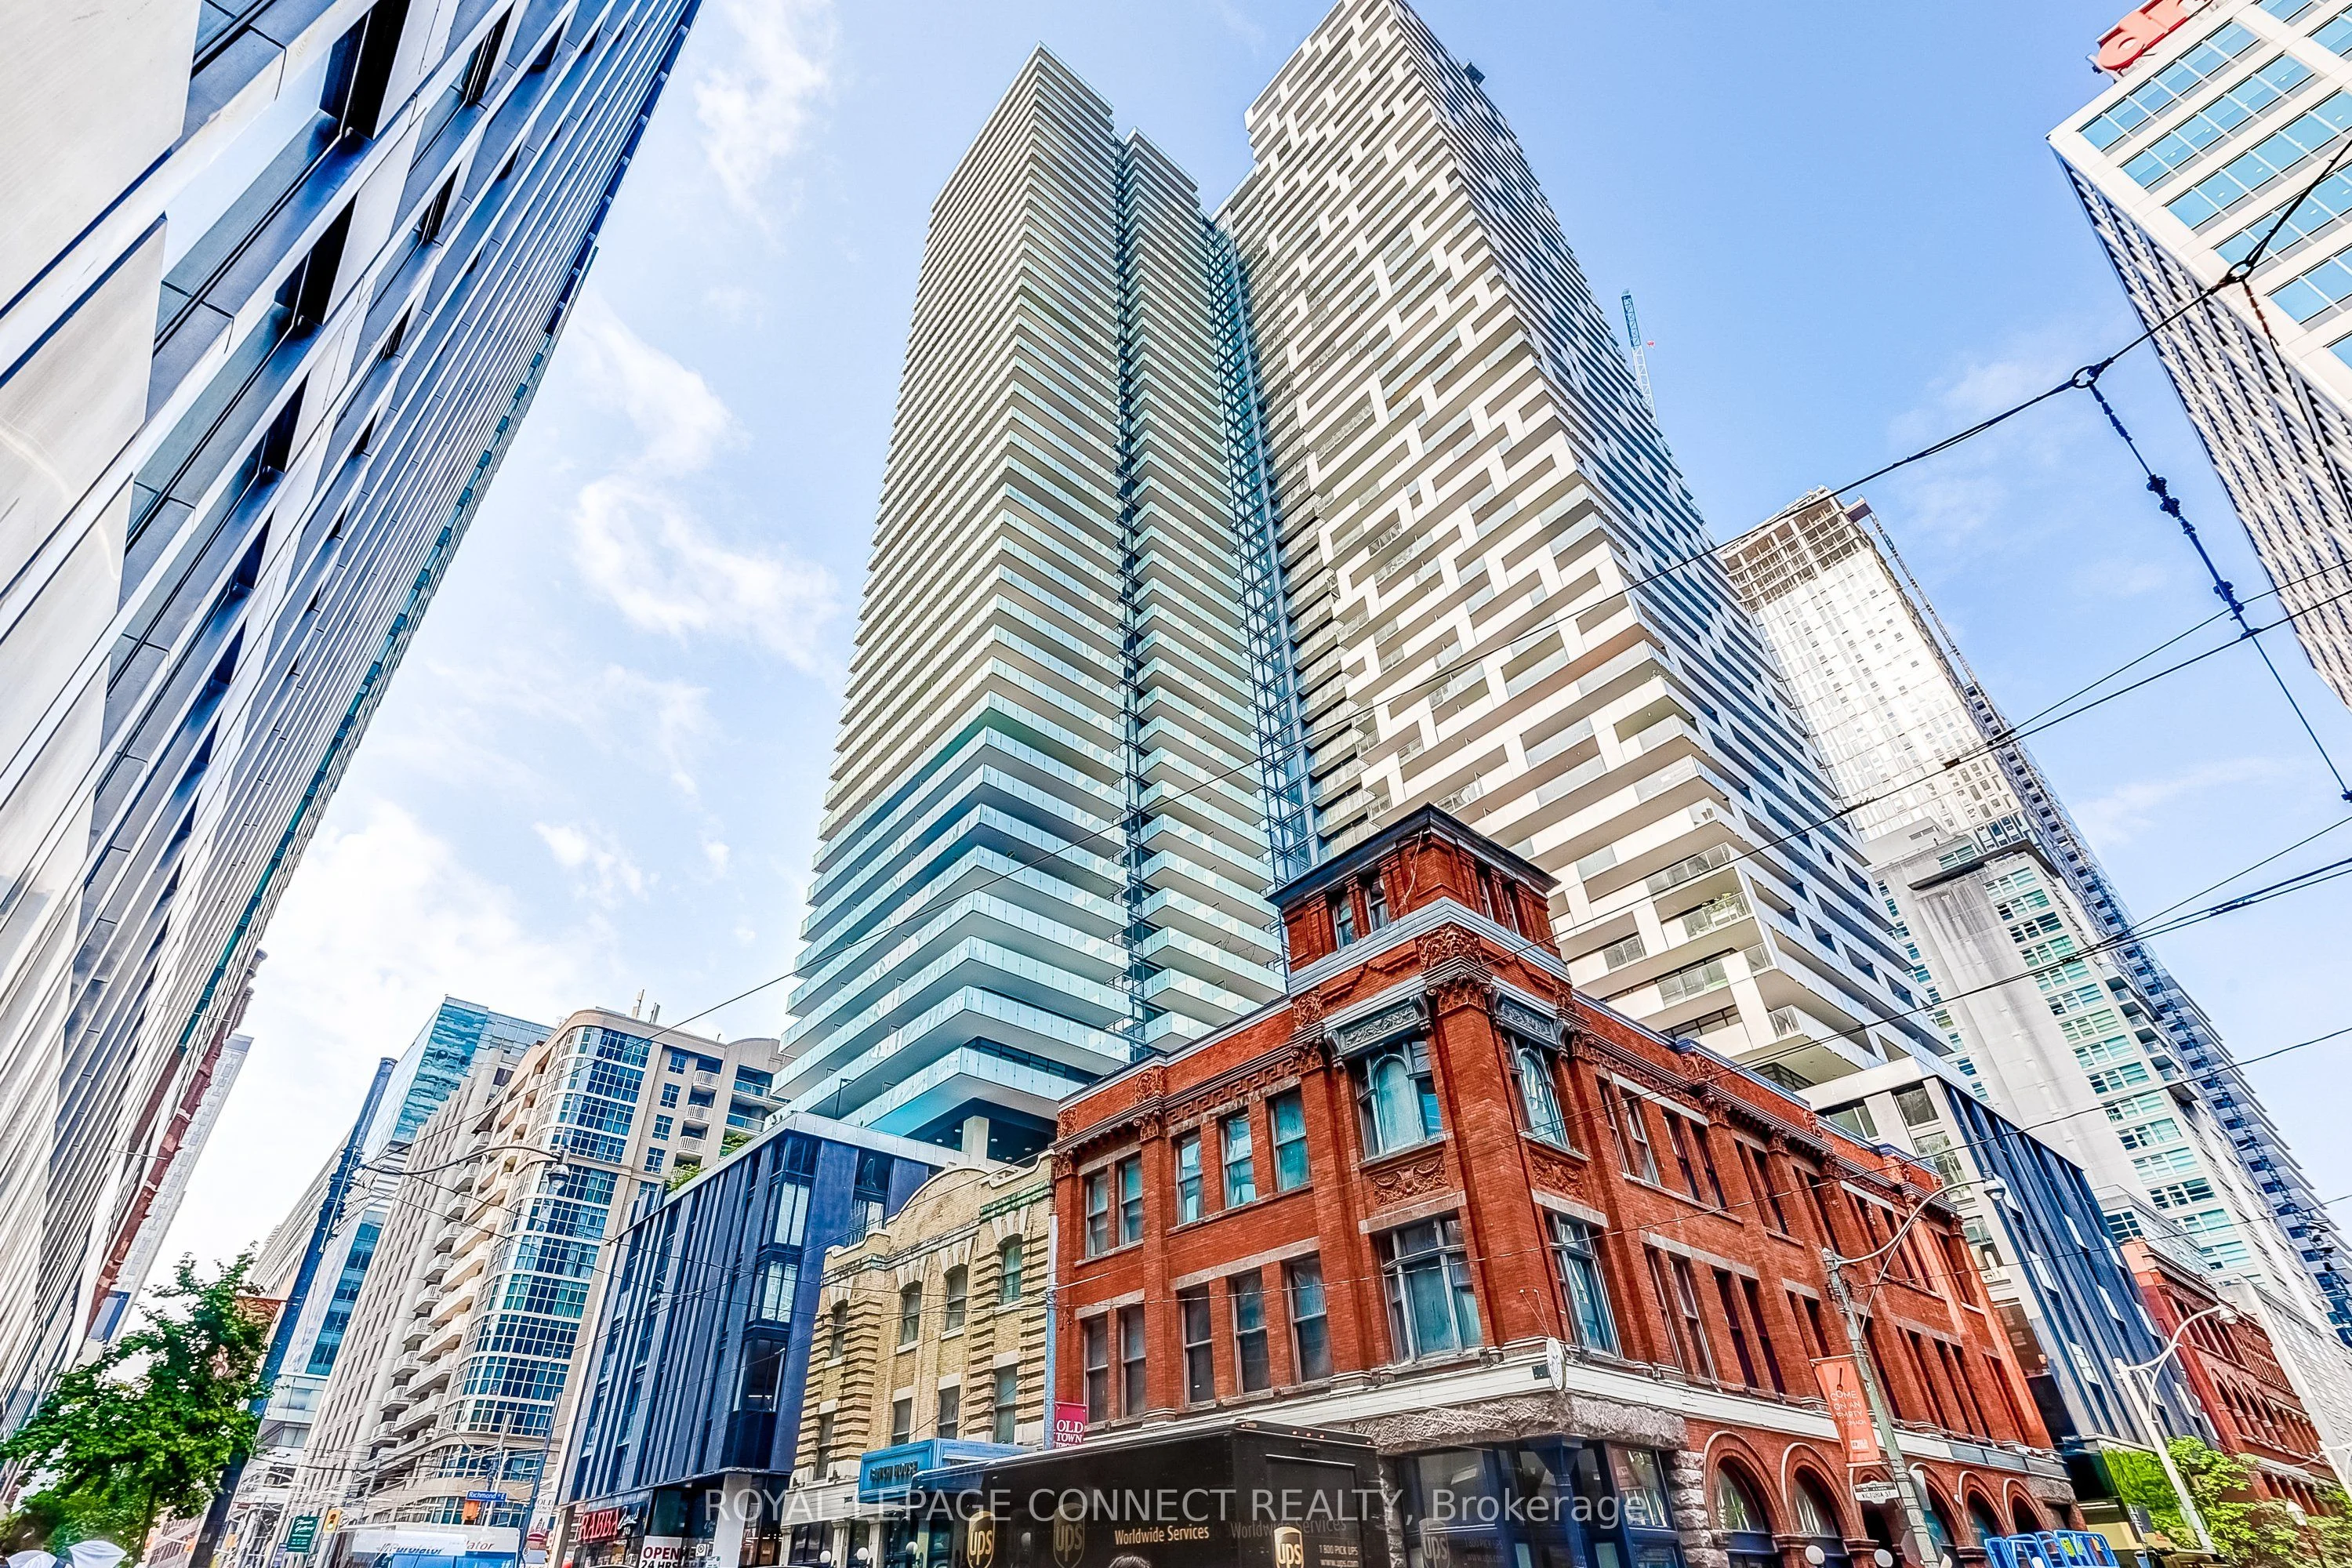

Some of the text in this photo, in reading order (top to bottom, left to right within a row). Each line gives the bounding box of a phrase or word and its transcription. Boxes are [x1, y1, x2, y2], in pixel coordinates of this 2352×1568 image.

[1830, 1390, 1857, 1401] COME
[1836, 1410, 1863, 1419] EMPTY
[1056, 1419, 1083, 1433] OLD
[1055, 1432, 1083, 1443] TOWN
[578, 1507, 619, 1541] RABBA
[1115, 1523, 1210, 1545] Worldwide Services
[643, 1546, 680, 1560] OPEN
[969, 1530, 993, 1566] ups
[1279, 1542, 1301, 1568] ups
